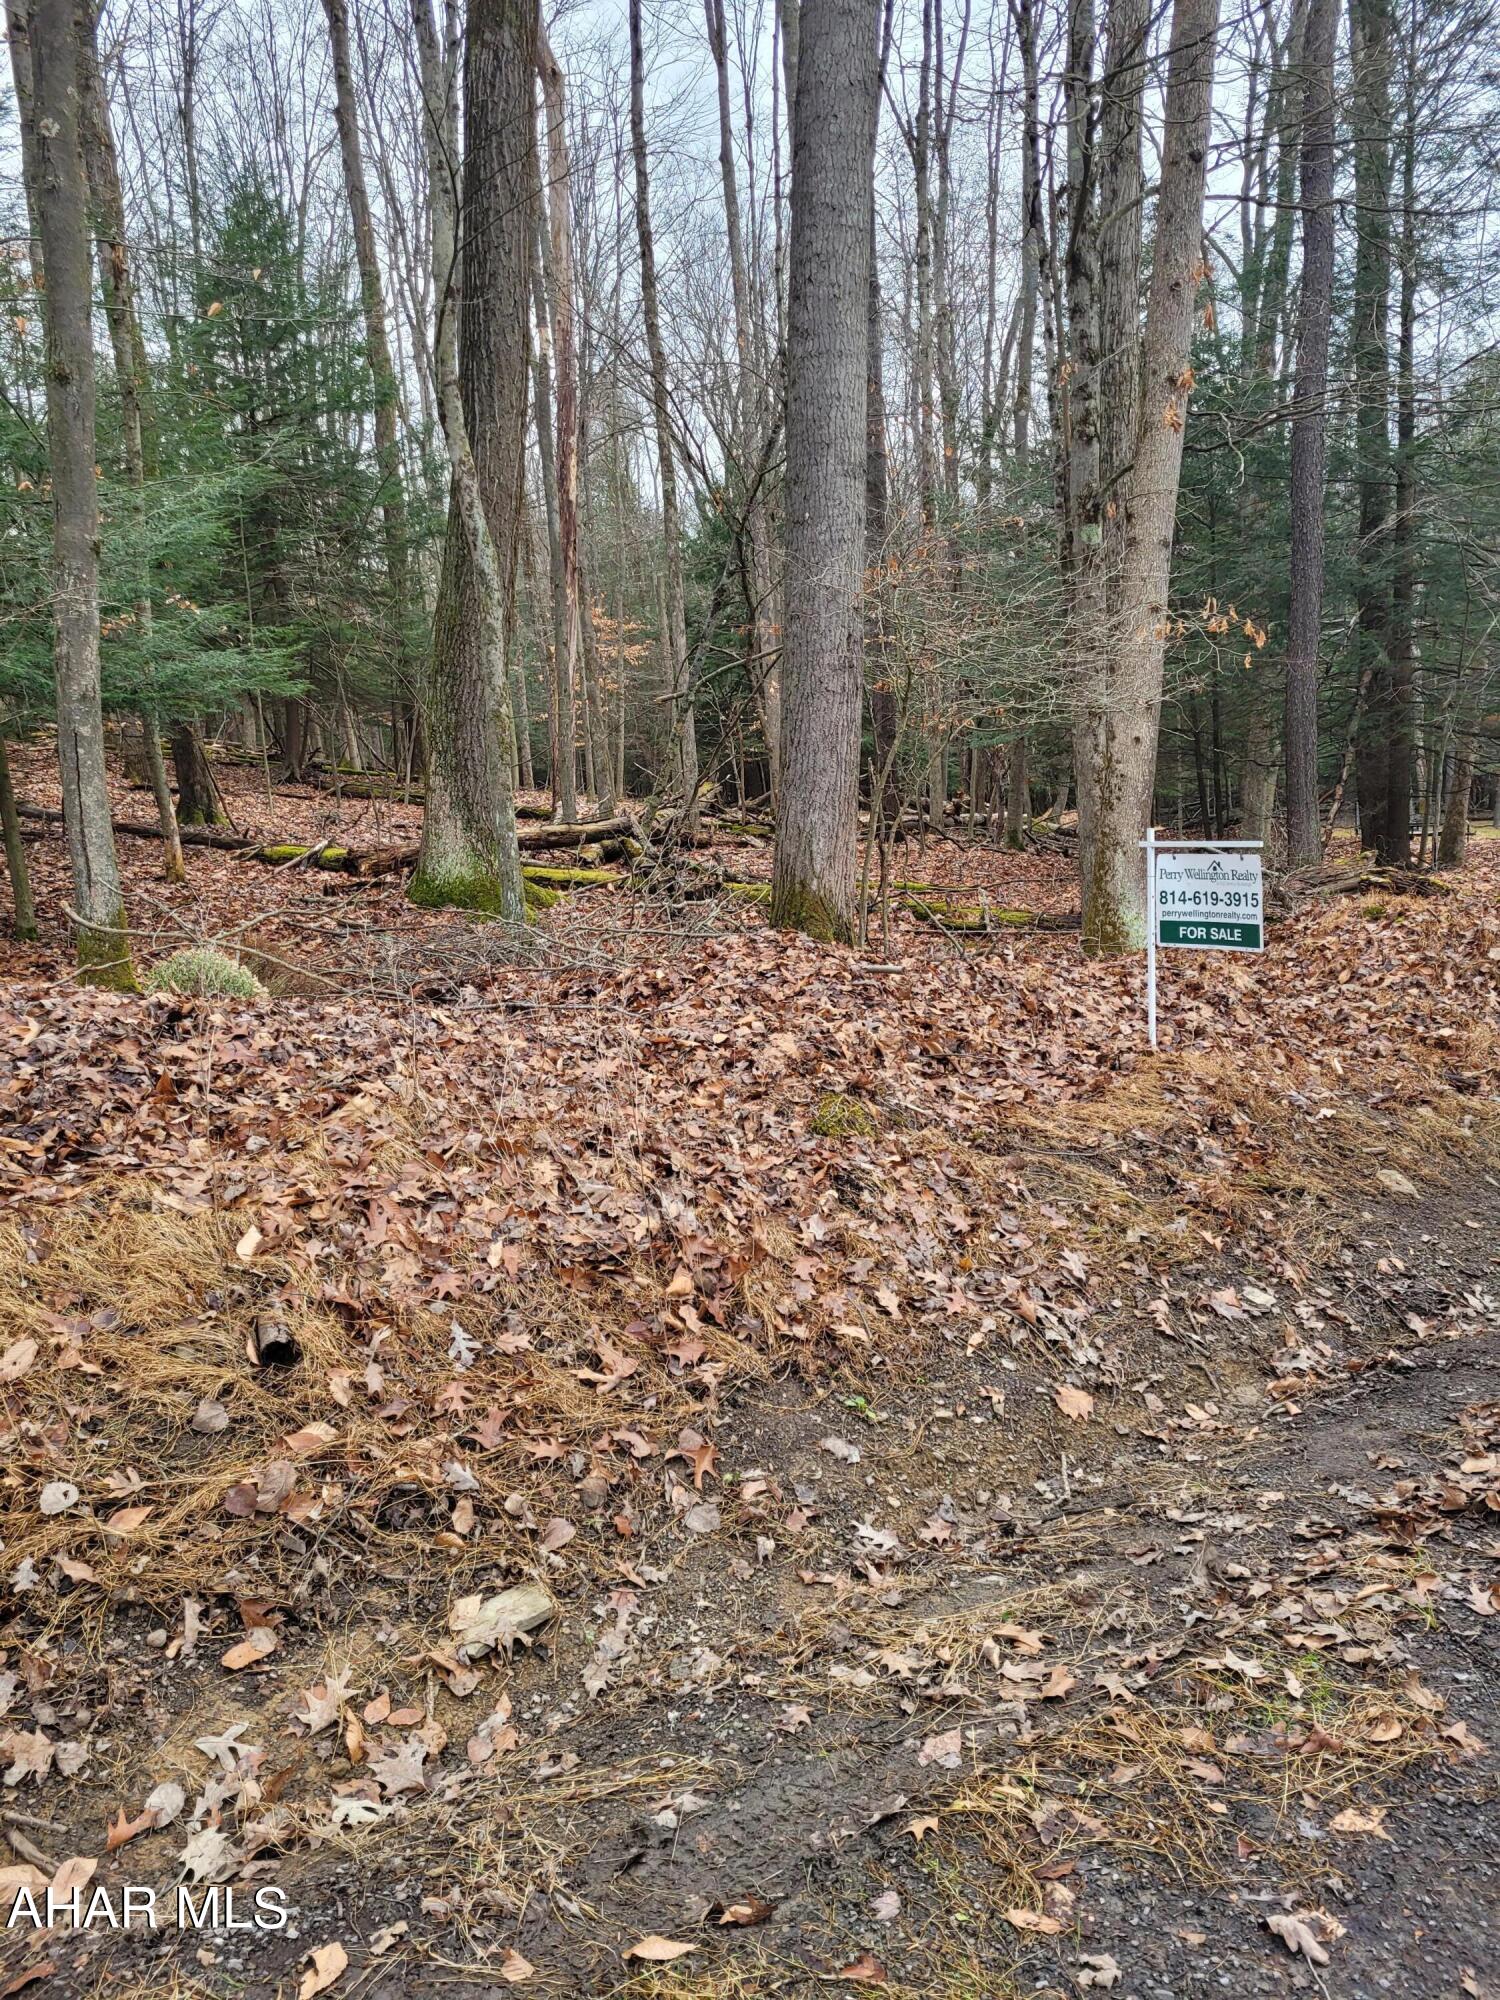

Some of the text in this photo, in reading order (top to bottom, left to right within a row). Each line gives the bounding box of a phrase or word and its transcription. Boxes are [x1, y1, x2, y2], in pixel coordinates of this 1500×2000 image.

[1159, 868, 1258, 884] Perry Wellington Realty
[1159, 890, 1259, 908] 814-619-3915
[1161, 910, 1258, 921] perrywellingtonrealty.com
[1179, 926, 1242, 941] FOR SALE
